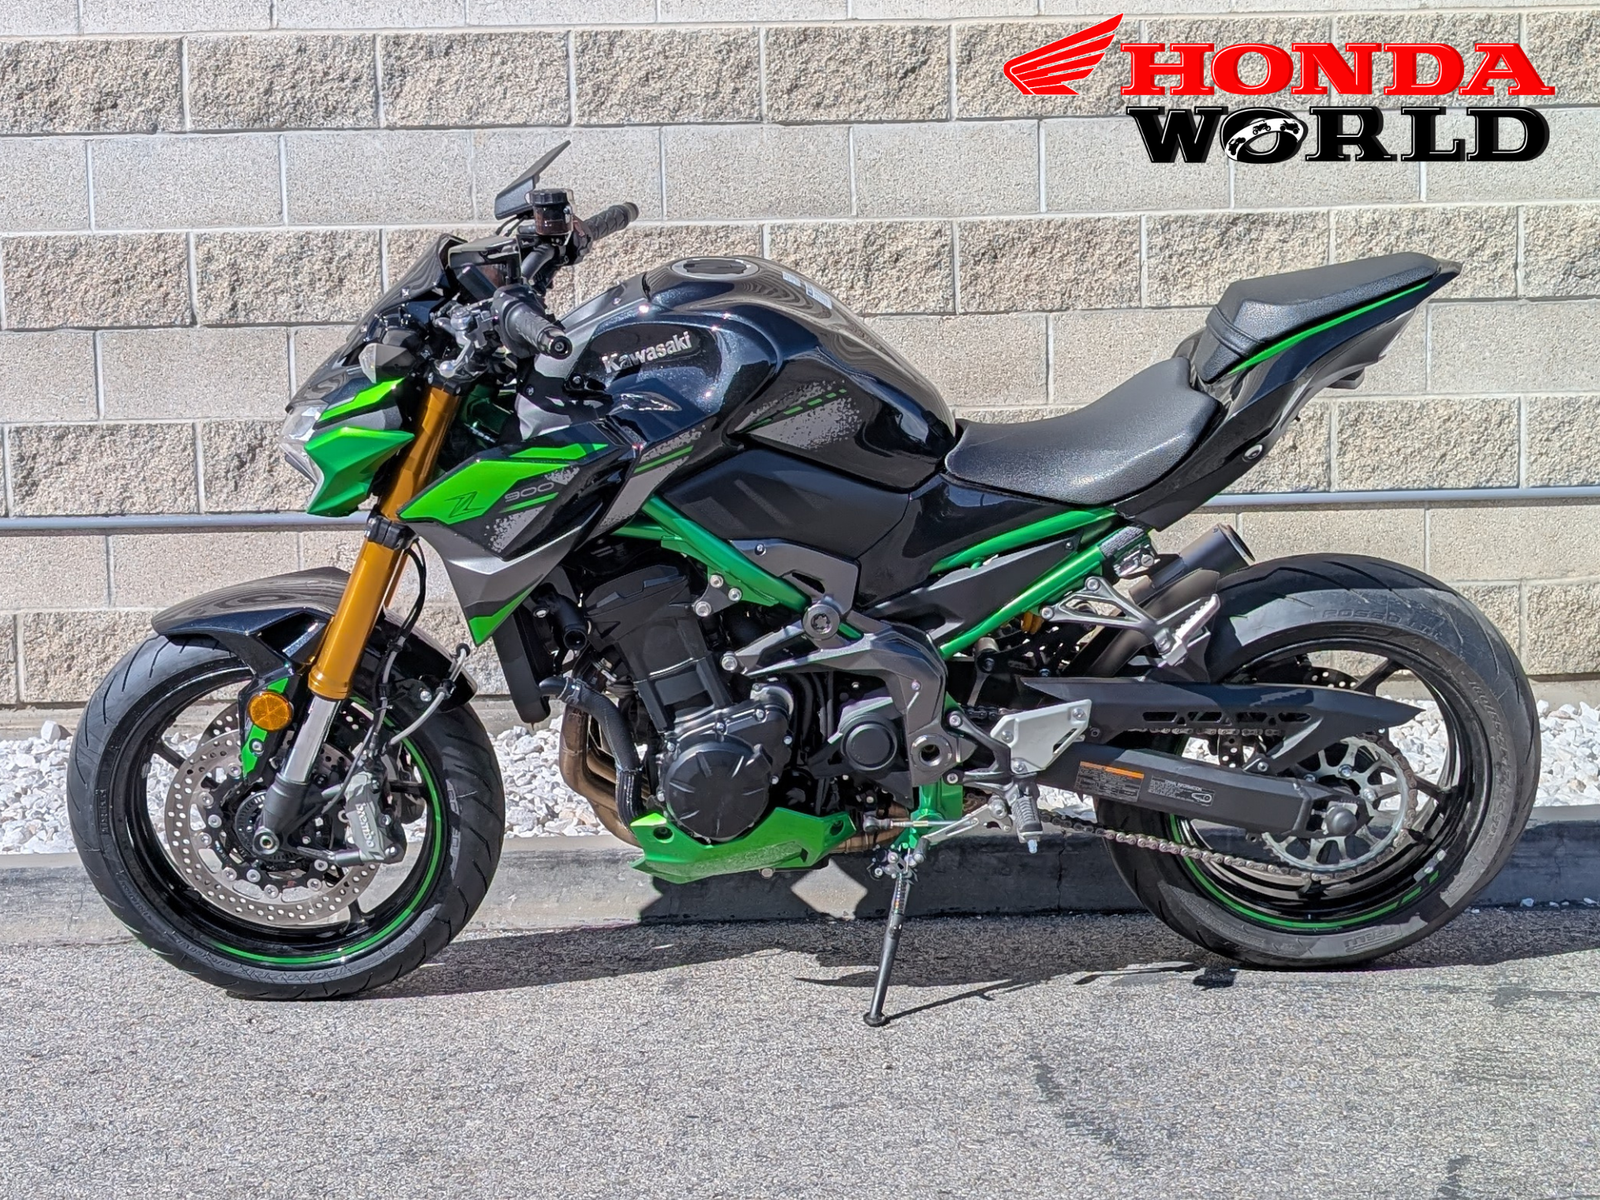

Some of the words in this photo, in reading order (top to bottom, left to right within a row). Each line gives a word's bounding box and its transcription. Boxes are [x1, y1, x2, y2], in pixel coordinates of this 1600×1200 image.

[601, 330, 693, 374] Kawasaki
[504, 481, 555, 503] 900
[355, 802, 375, 848] brembo
